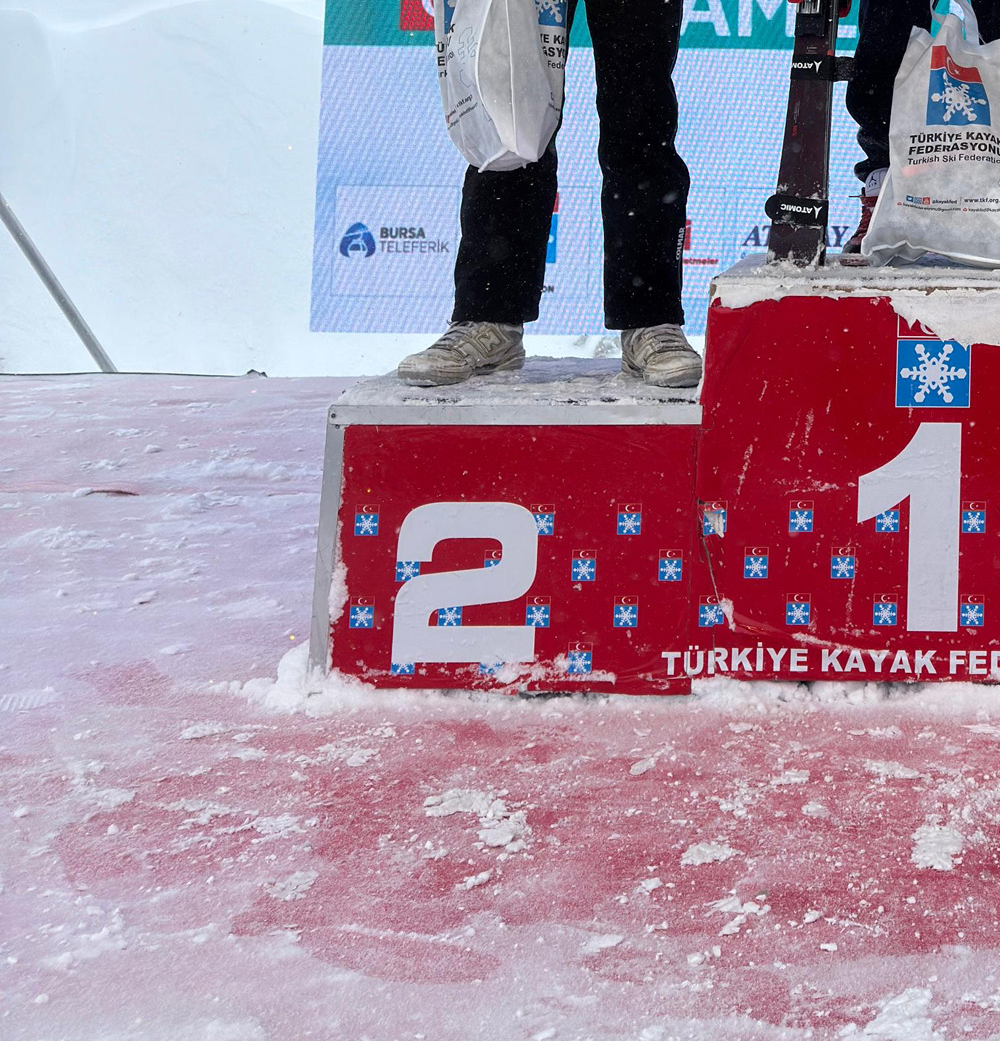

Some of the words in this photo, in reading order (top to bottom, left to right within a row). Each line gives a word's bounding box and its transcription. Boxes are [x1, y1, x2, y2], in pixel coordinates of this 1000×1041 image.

[910, 131, 962, 144] TÜRKİYE
[907, 156, 940, 166] Turkish
[942, 155, 957, 163] Ski
[780, 203, 813, 214] ATOMIC
[379, 226, 425, 239] BURSA
[379, 239, 449, 253] TELEFERİK
[675, 227, 686, 260] COLMAR
[857, 422, 962, 632] 1
[391, 501, 539, 664] 2
[661, 642, 808, 677] TÜRKİYE
[821, 649, 937, 675] KAYAK
